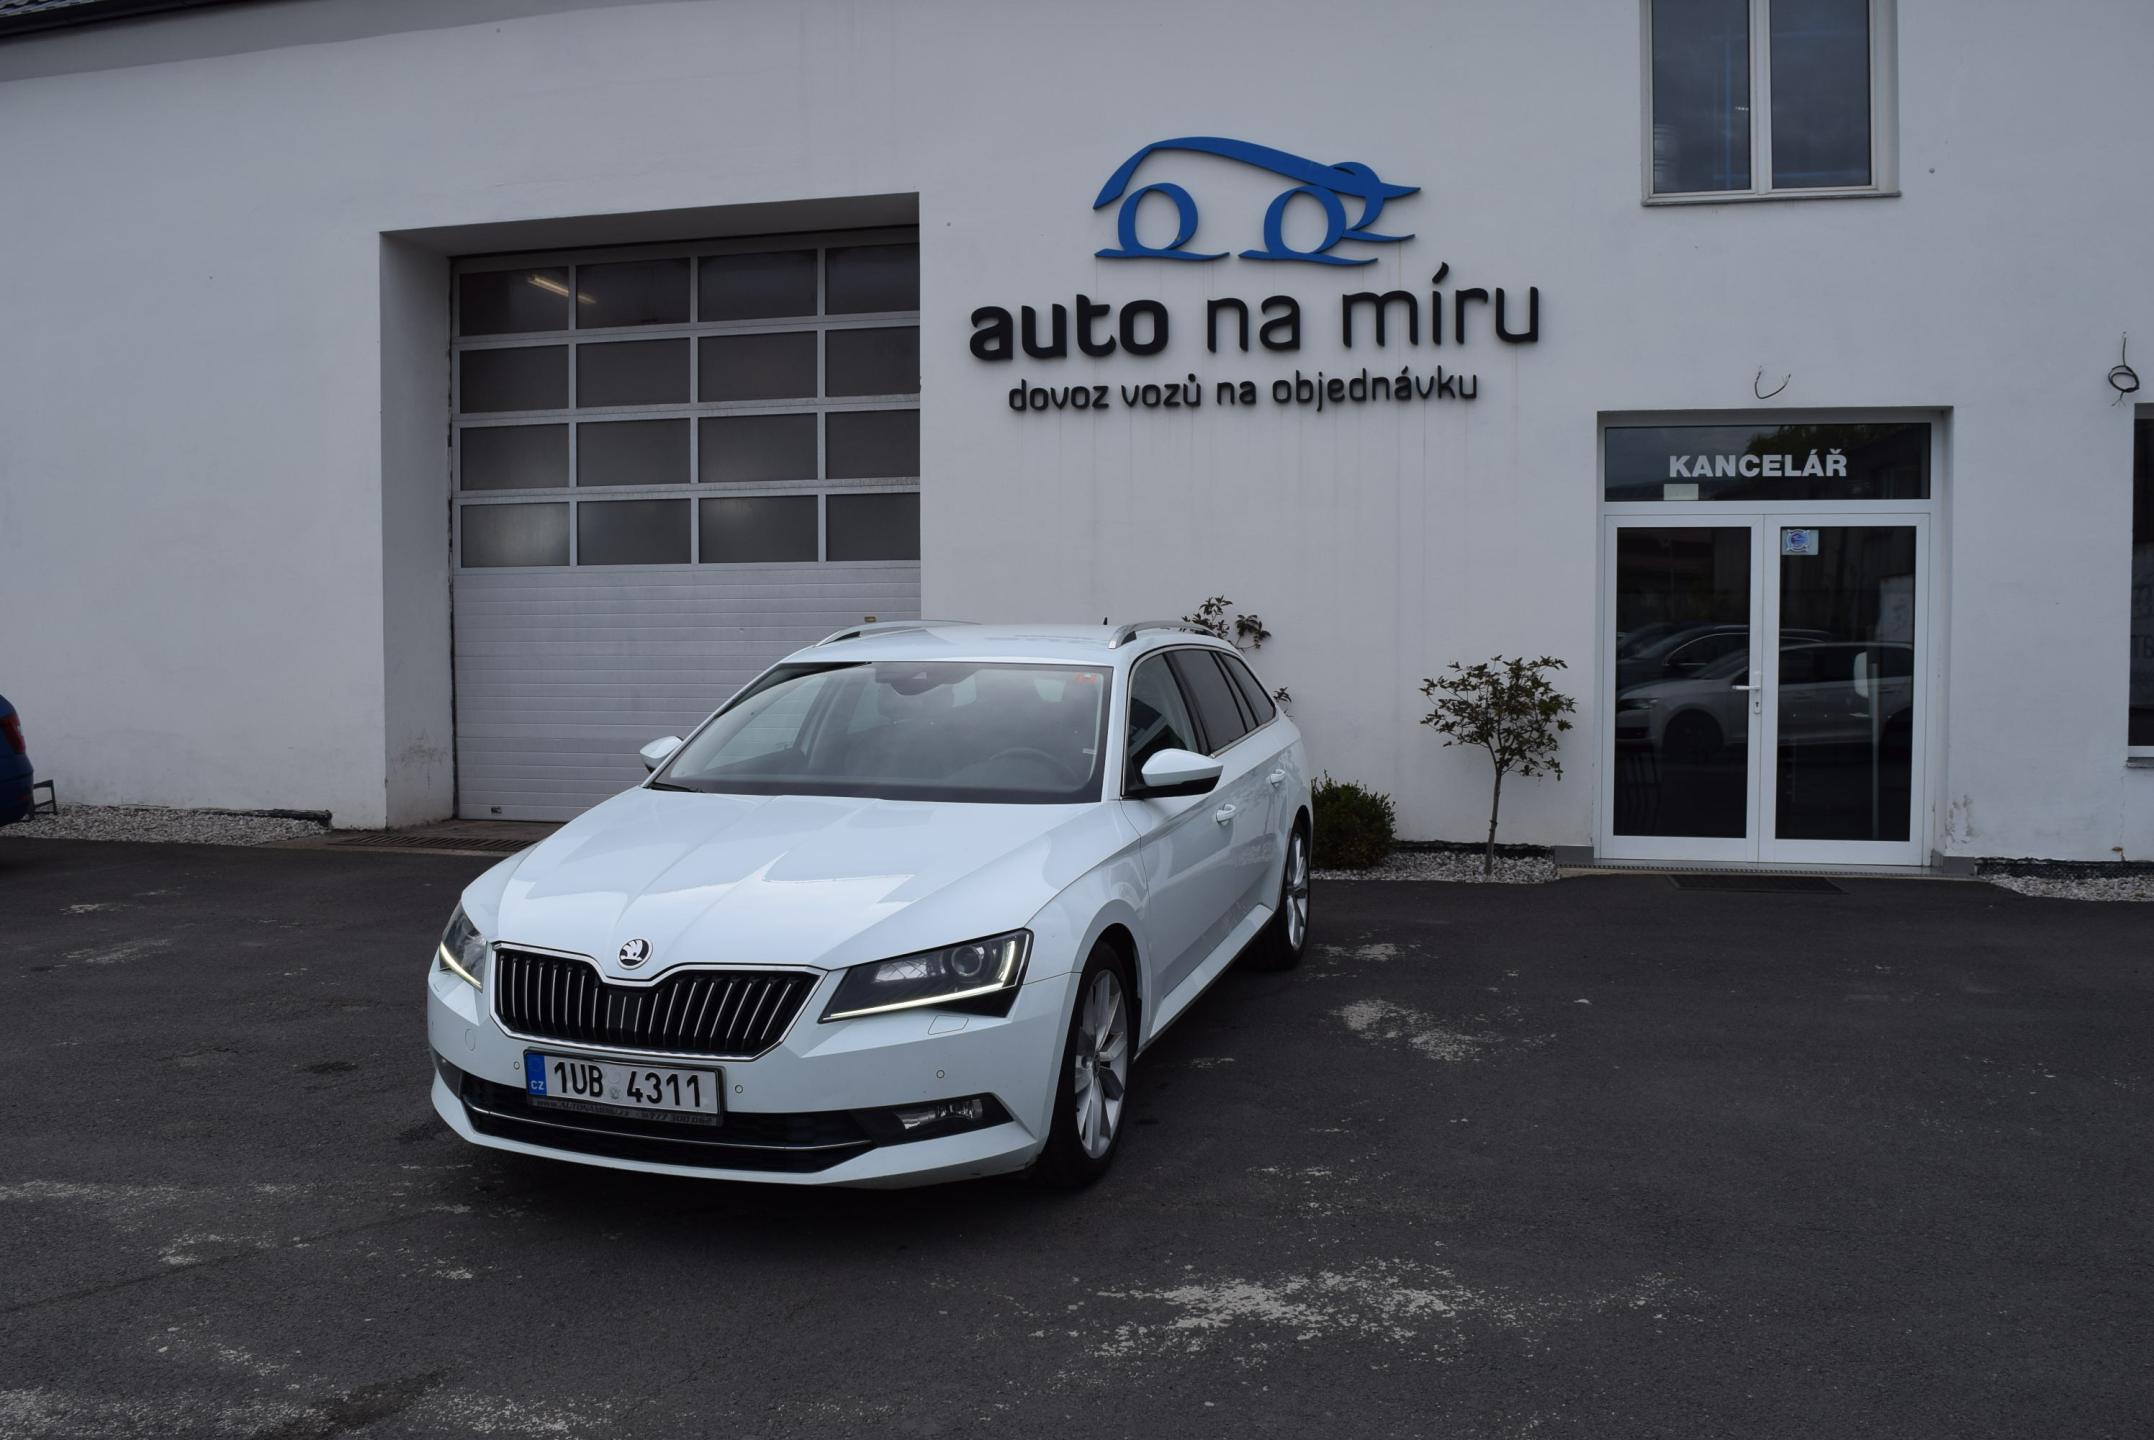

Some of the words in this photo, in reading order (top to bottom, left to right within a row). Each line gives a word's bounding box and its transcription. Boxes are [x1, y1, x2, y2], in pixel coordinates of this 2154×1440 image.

[970, 294, 1169, 361] auto
[1207, 295, 1300, 352] na
[1343, 262, 1539, 347] míru
[1008, 379, 1110, 413] dovoz
[1121, 374, 1202, 410] vozů
[1216, 380, 1257, 407] na
[1272, 365, 1478, 412] objednávku
[1669, 448, 1848, 478] KANCELÁŘ
[530, 1079, 545, 1091] CZ
[554, 1061, 604, 1098] 1UB
[626, 1070, 701, 1108] 4311
